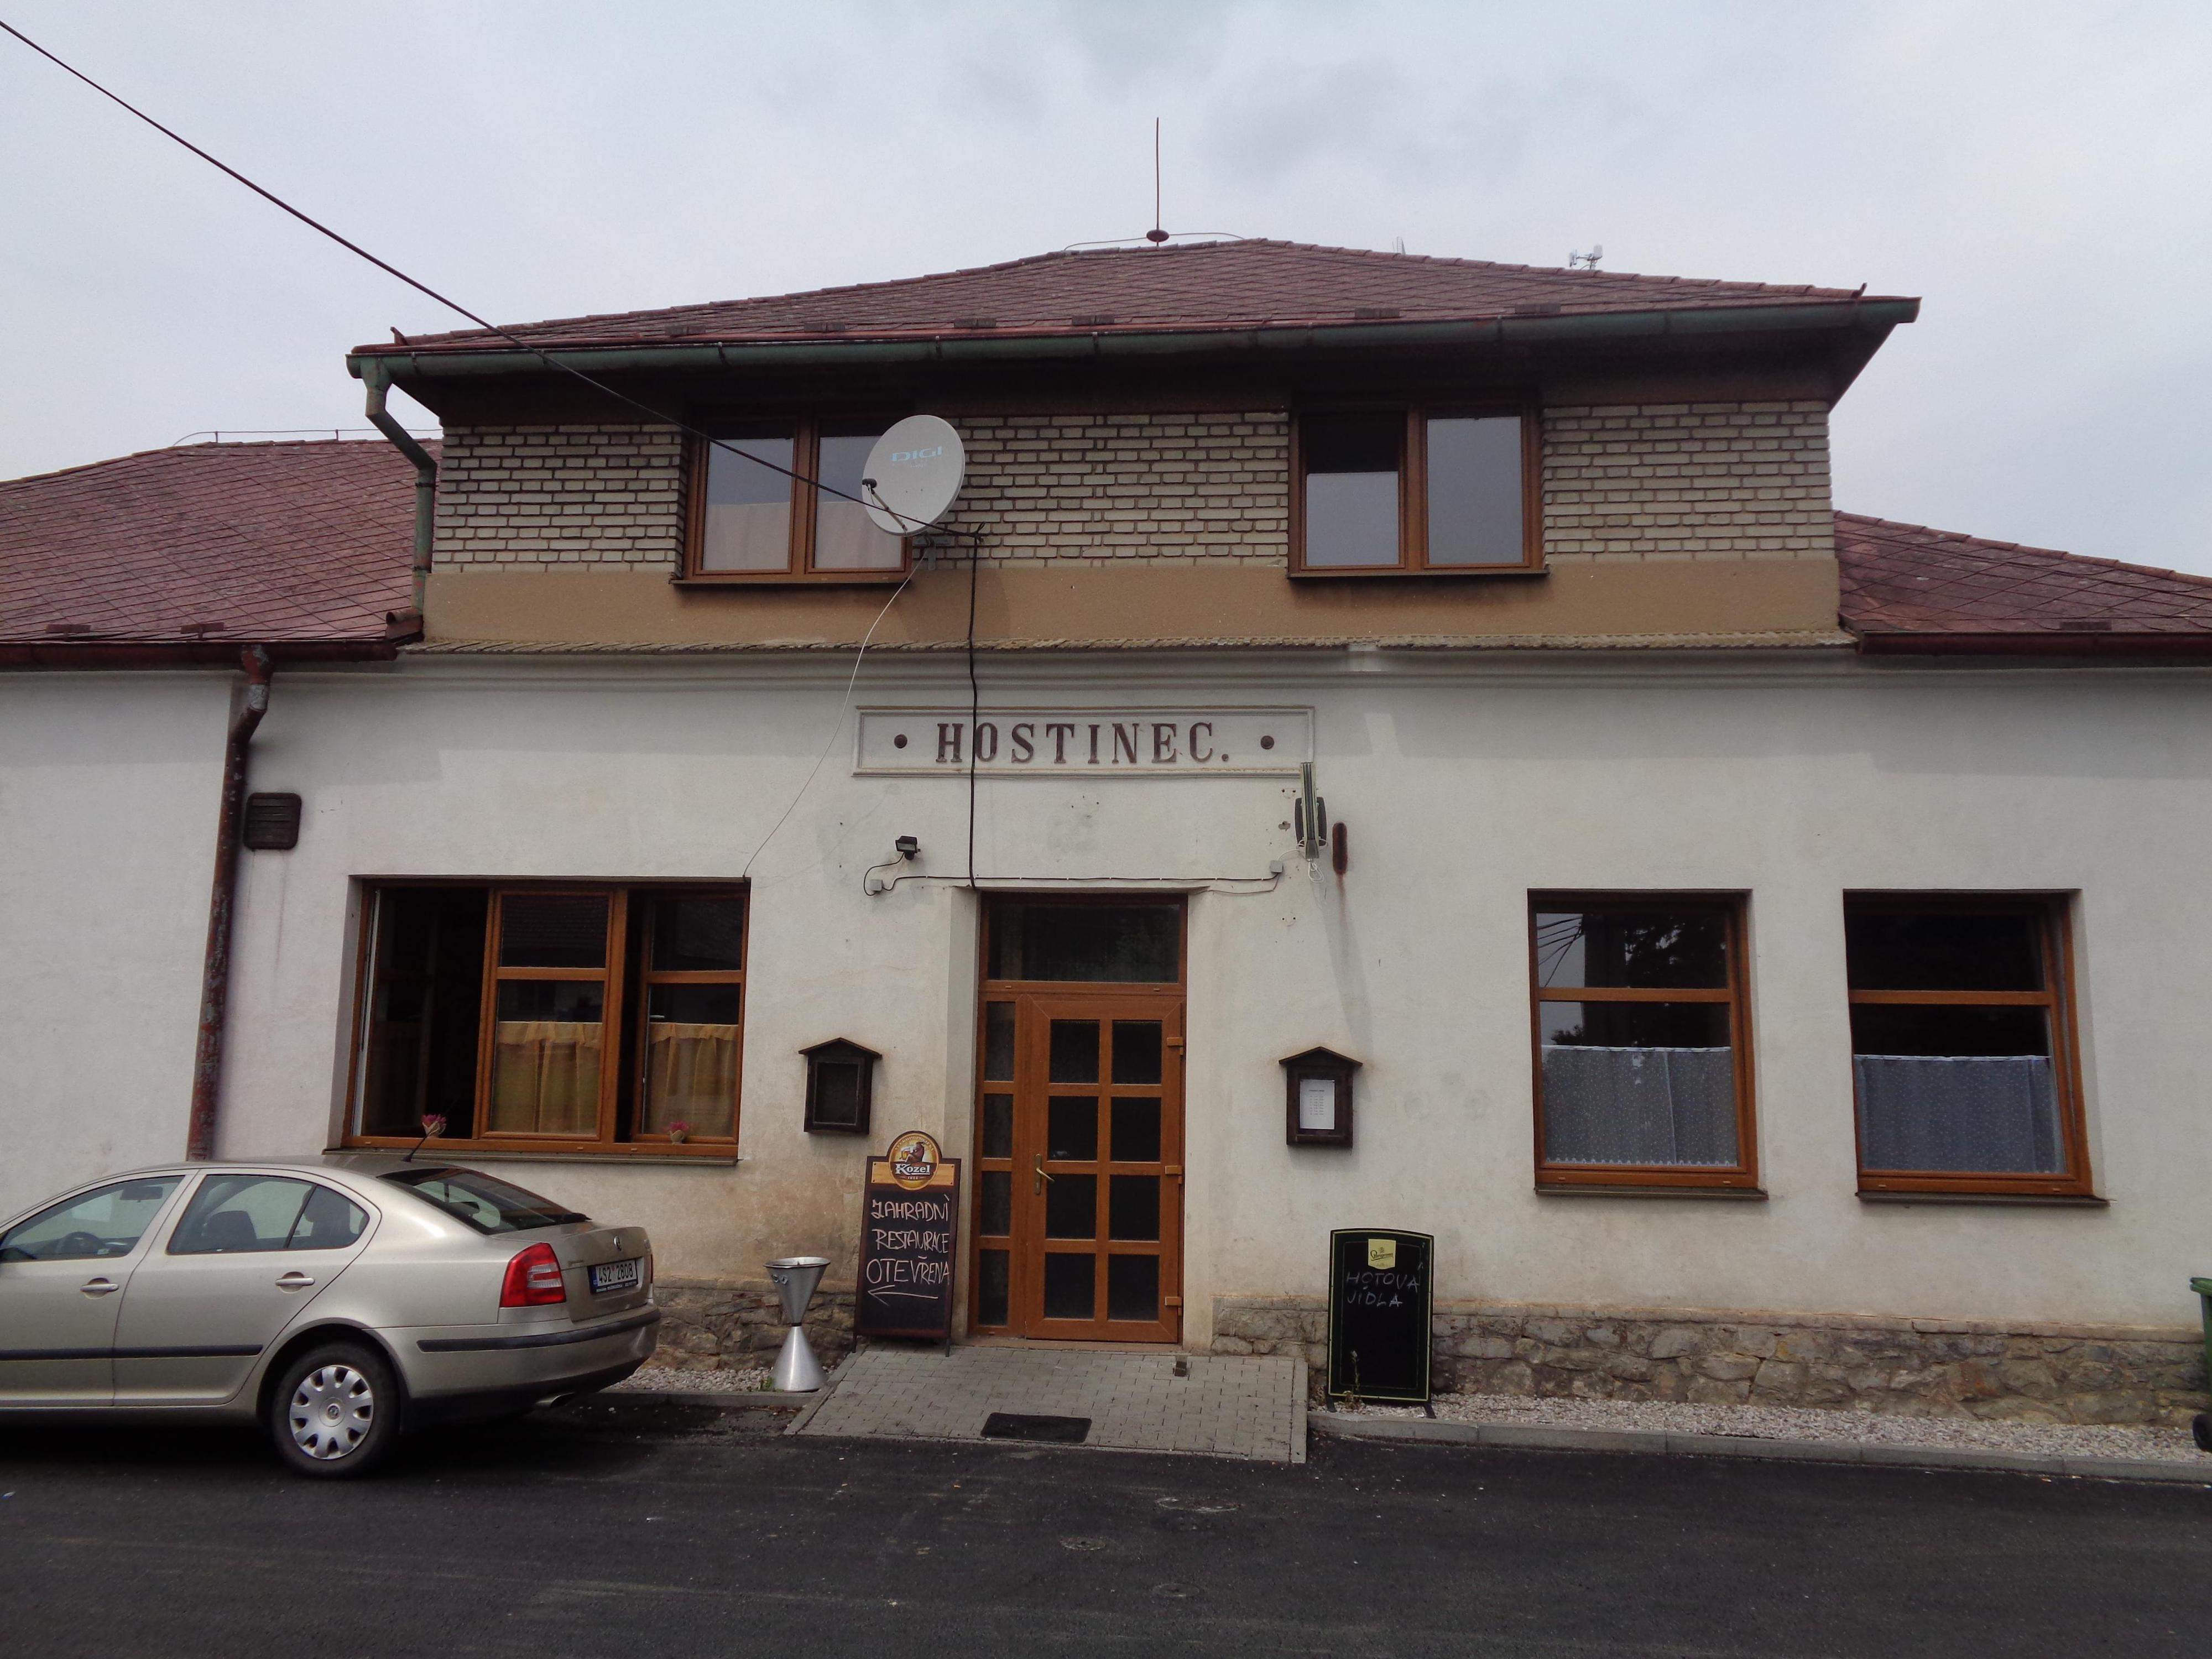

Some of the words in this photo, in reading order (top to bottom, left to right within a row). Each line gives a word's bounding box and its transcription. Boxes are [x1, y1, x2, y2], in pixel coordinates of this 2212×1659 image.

[891, 446, 942, 461] DIGI
[895, 1164, 930, 1175] Kozel
[872, 1229, 950, 1253] RESTAURACE
[598, 1266, 612, 1283] 4S2
[616, 1263, 633, 1280] 2808
